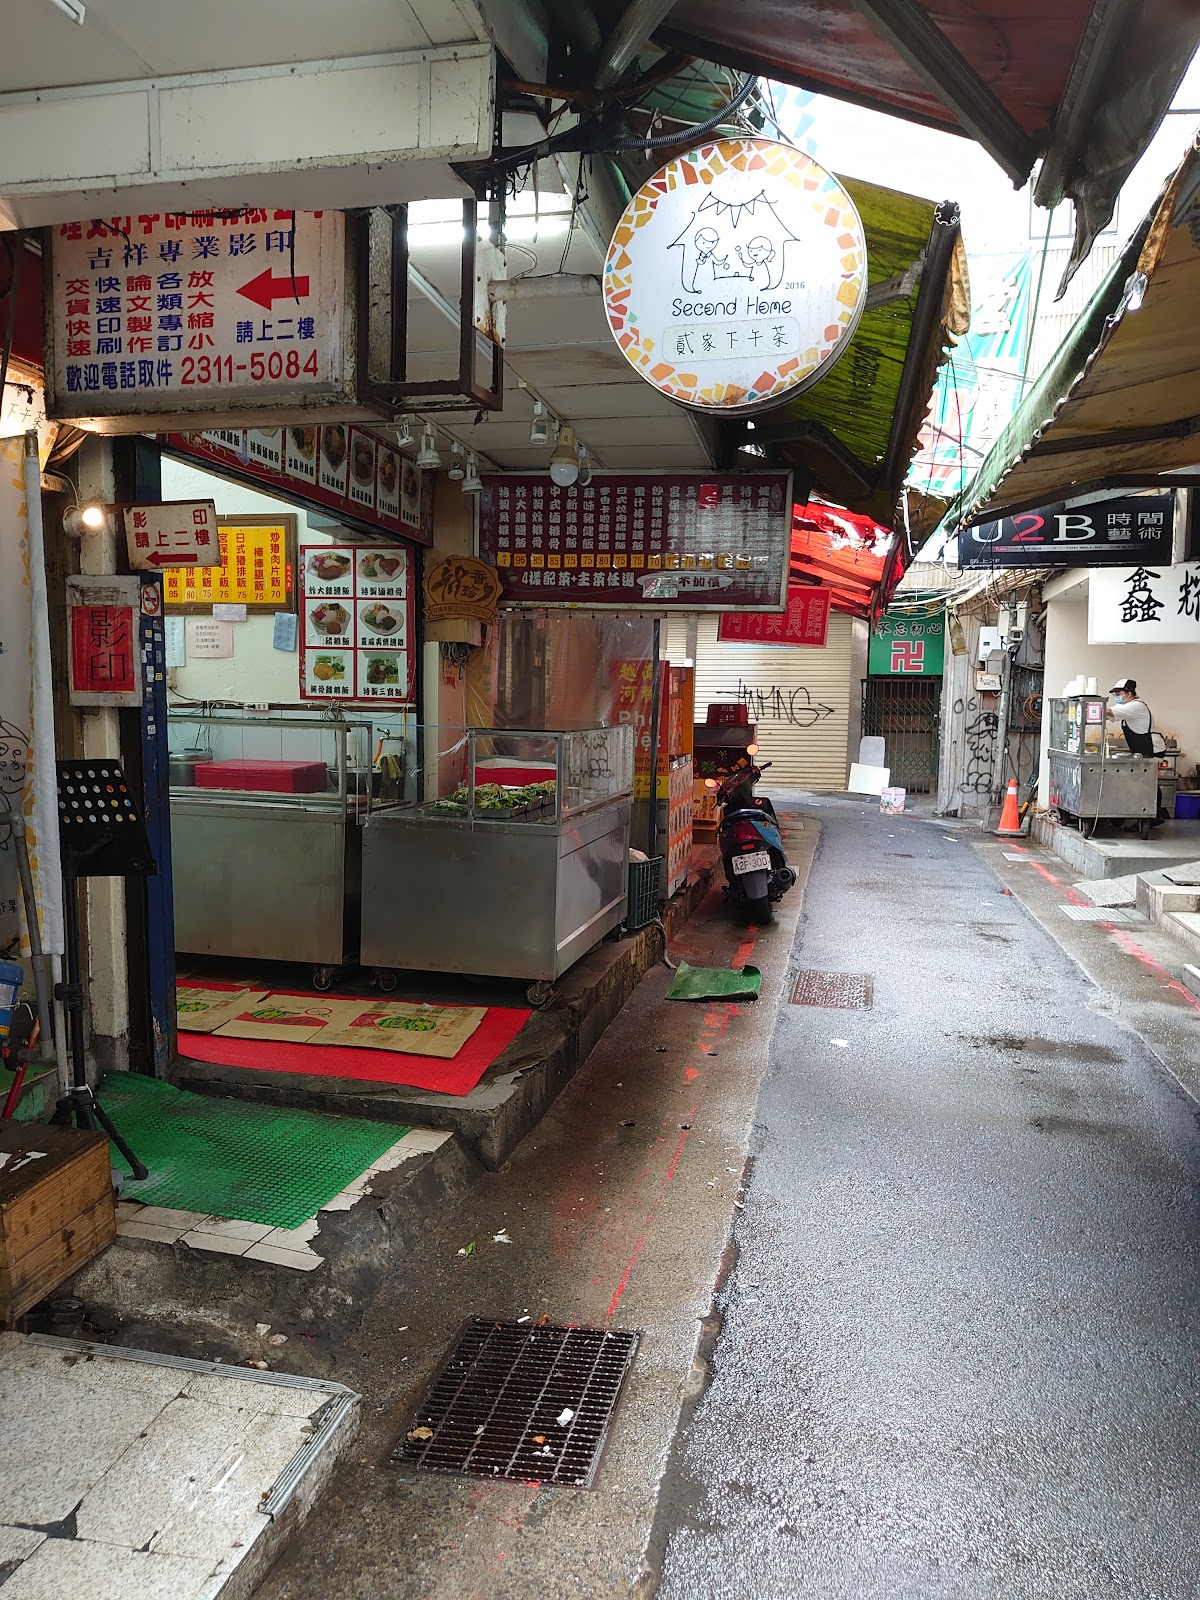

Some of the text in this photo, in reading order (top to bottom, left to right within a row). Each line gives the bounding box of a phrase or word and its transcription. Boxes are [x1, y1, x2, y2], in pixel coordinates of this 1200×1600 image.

[88, 229, 294, 271] 吉祥專業影印
[784, 281, 806, 291] 2016
[157, 272, 183, 352] 各類專訂
[187, 270, 215, 350] 放大縮小
[671, 296, 792, 318] Second Home
[65, 278, 91, 358] 交貨快速
[95, 276, 122, 355] 快速印刷
[126, 274, 153, 354] 論文製作
[235, 316, 317, 344] 請上二樓
[676, 324, 789, 356] 貳家下午茶
[66, 349, 319, 393] 歡迎電話取件 2311-5084
[133, 508, 209, 529] 影印
[1107, 512, 1164, 525] 時間
[971, 513, 1096, 542] U2B
[135, 529, 211, 548] 請上二樓
[1107, 528, 1162, 541] 藝術
[515, 555, 526, 564] 95
[533, 555, 543, 565] 85
[549, 556, 559, 565] 85
[566, 555, 576, 565] 75
[583, 555, 593, 565] 75
[599, 555, 609, 565] 80
[615, 555, 626, 565] 75
[633, 556, 643, 566] 75
[650, 557, 660, 566] 70
[168, 590, 179, 598] 85
[202, 589, 212, 598] 75
[219, 590, 229, 598] 75
[236, 591, 247, 599] 75
[254, 593, 264, 601] 75
[271, 591, 281, 599] 70
[876, 621, 943, 636] 不忘初心
[88, 610, 126, 682] 影印
